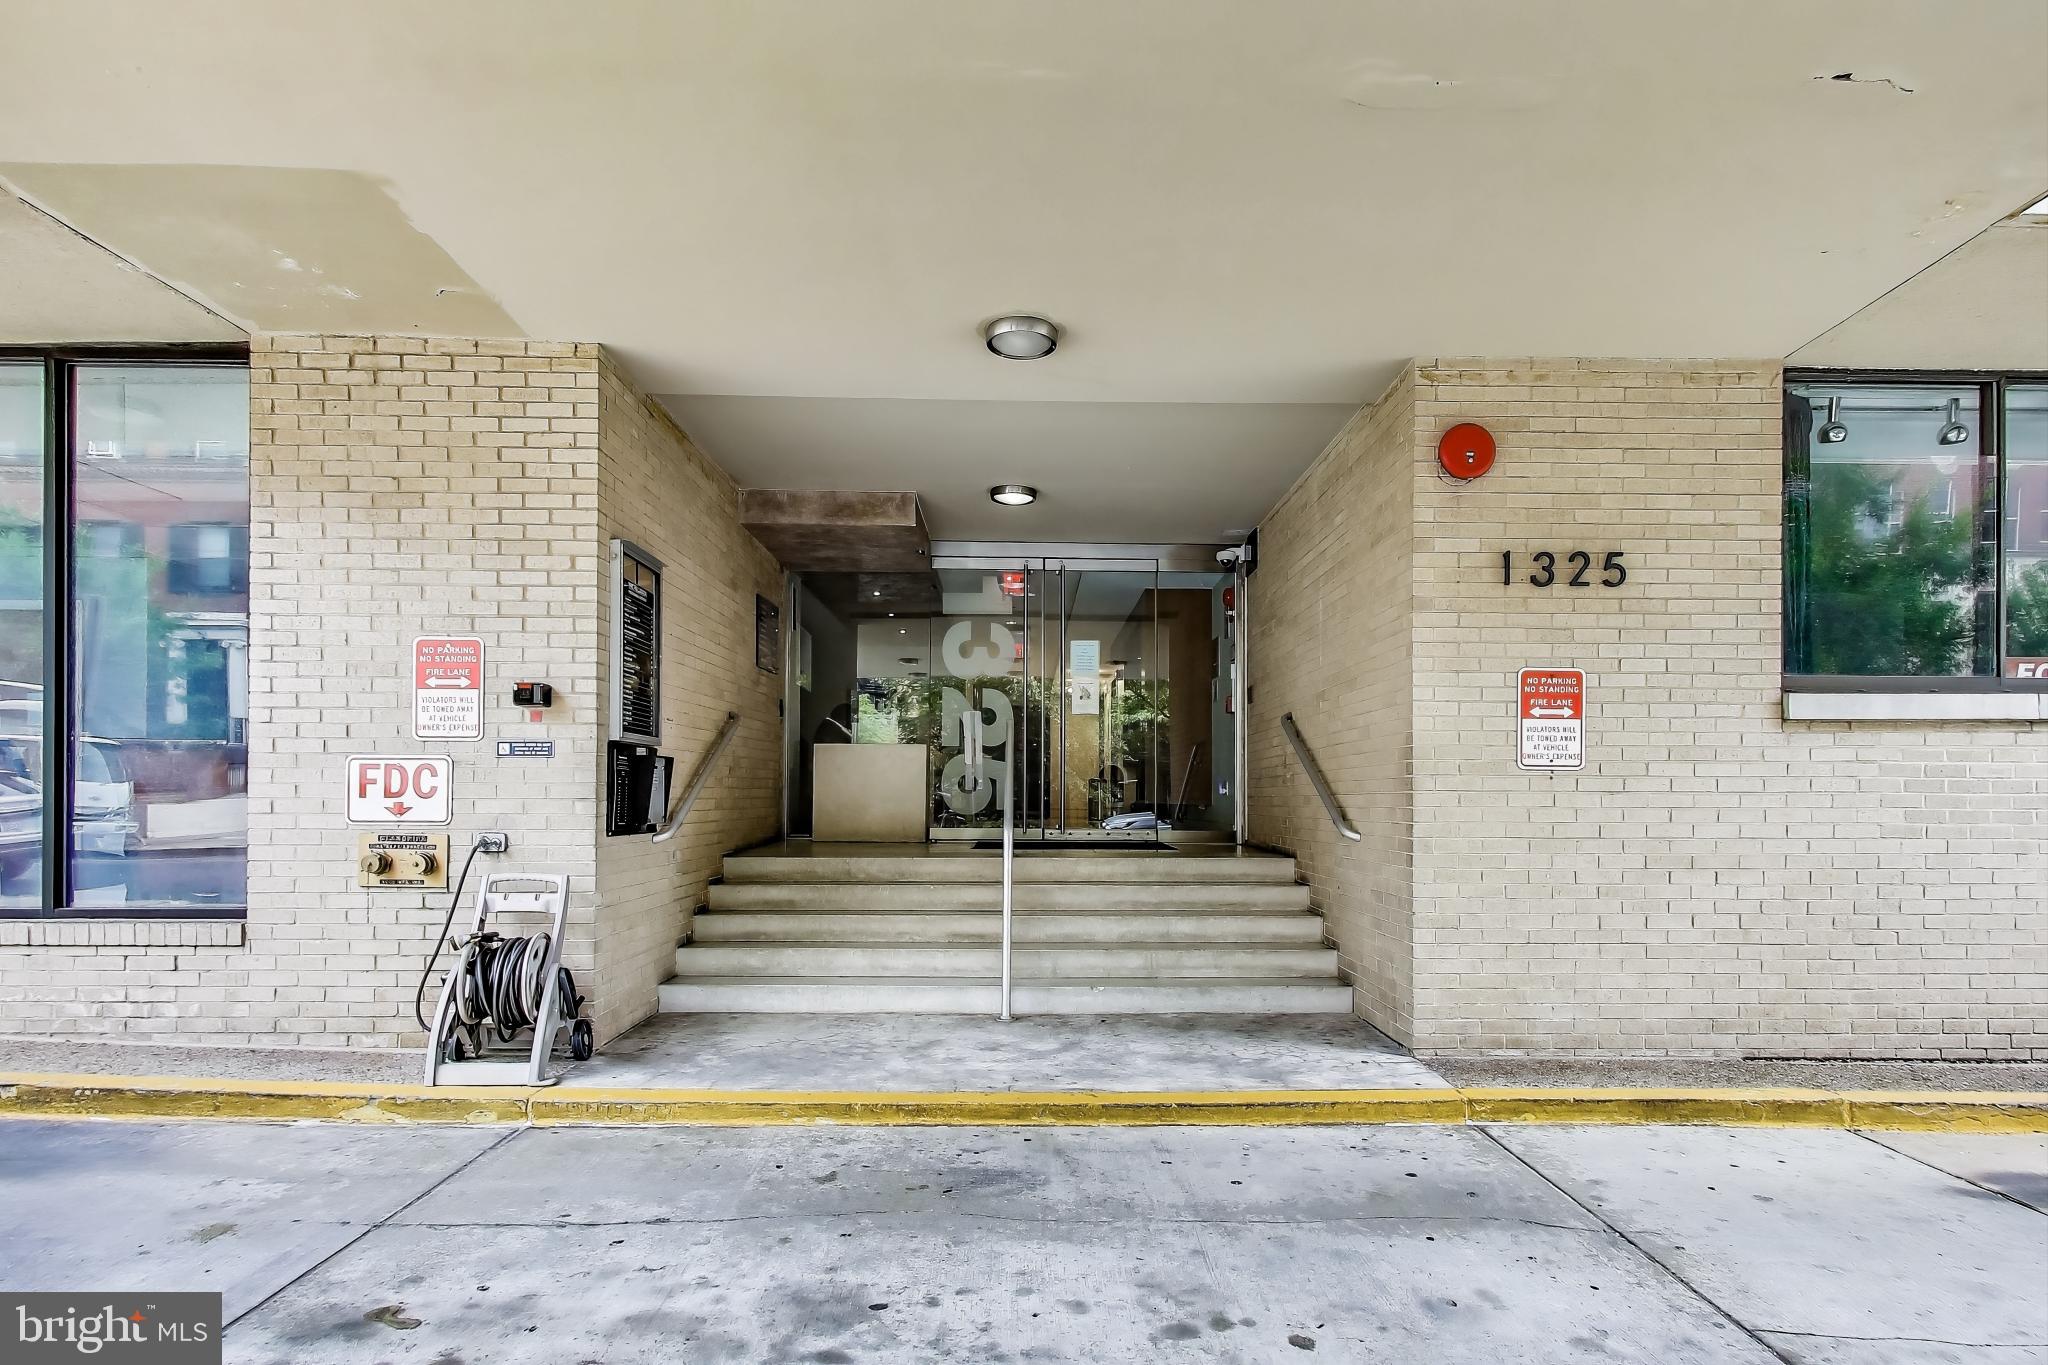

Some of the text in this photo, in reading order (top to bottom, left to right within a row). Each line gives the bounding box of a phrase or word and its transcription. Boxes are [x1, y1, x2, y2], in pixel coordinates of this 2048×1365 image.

[1502, 550, 1627, 588] 1325
[426, 668, 471, 676] FIRE LANE
[421, 696, 475, 704] VIOLATORS WILL
[1530, 698, 1548, 706] FIRE
[448, 724, 478, 732] EXPENSE
[1562, 726, 1577, 734] WILL
[1537, 735, 1558, 743] TOWED
[1552, 753, 1580, 761] EXPENSE
[358, 763, 438, 799] FDC
